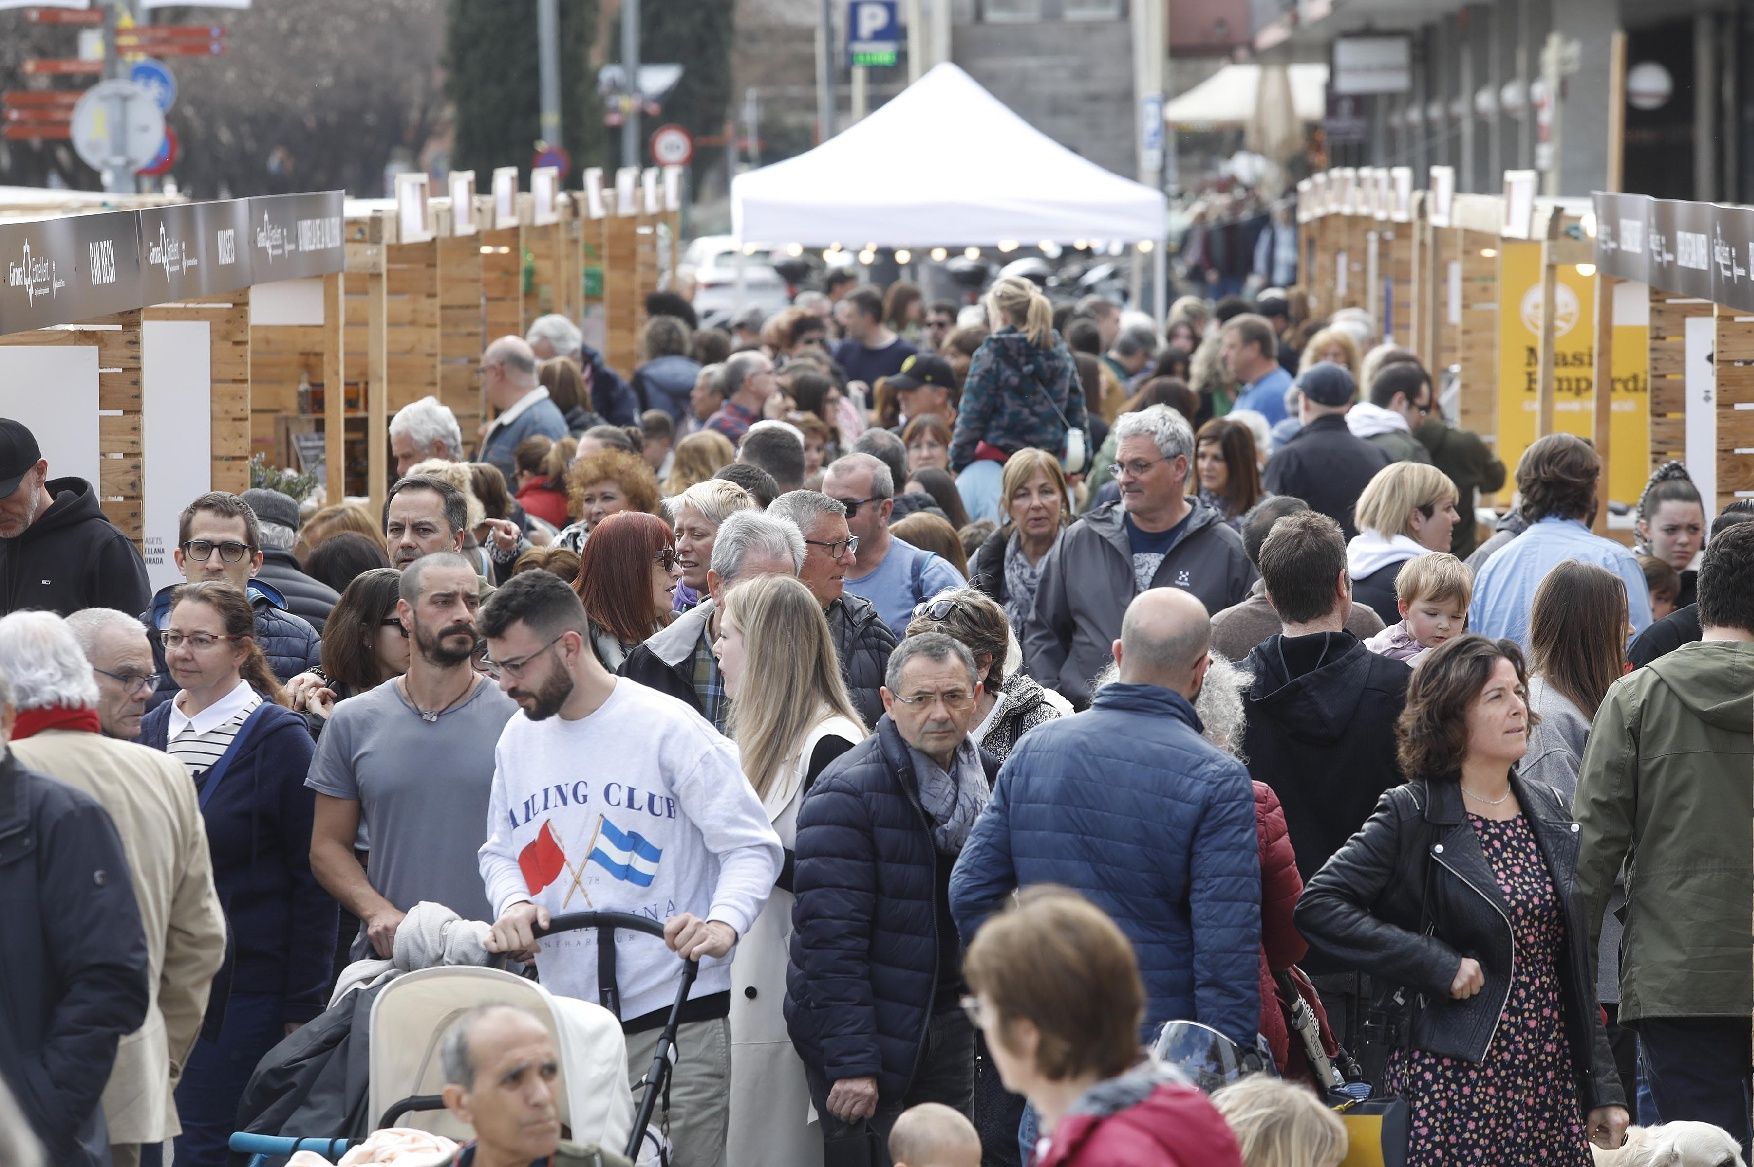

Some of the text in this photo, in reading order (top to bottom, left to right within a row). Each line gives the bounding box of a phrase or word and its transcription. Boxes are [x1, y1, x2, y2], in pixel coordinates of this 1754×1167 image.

[857, 4, 890, 39] P
[1525, 346, 1613, 368] Masi
[1525, 371, 1648, 396] Emprd
[603, 782, 676, 819] CLUB
